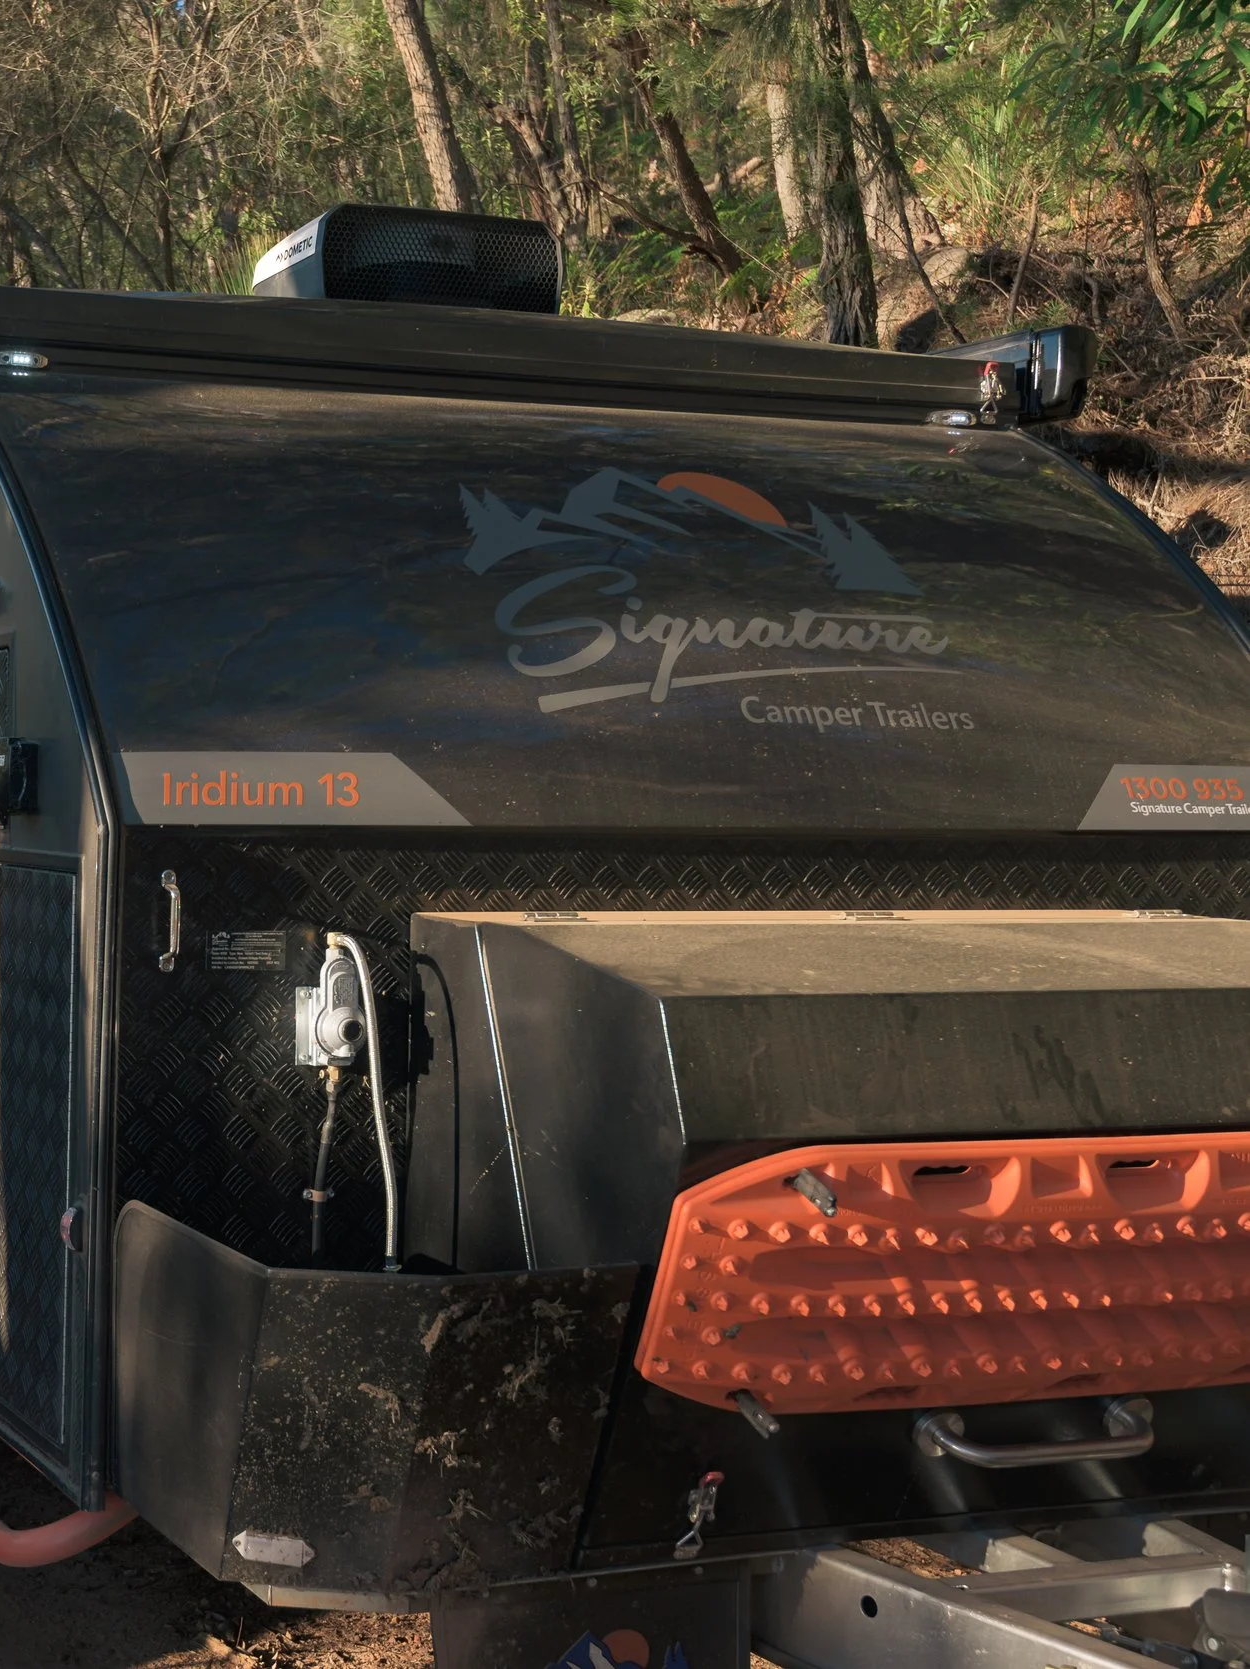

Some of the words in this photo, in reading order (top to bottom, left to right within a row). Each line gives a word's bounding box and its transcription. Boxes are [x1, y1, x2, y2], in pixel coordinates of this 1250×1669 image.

[283, 236, 313, 260] DOMETIC
[494, 565, 949, 703] Signature
[740, 695, 863, 732] Camper
[865, 700, 975, 731] Trailers
[162, 769, 304, 807] Iridium
[316, 771, 361, 807] 13
[1119, 776, 1188, 801] 1300
[1192, 778, 1245, 801] 935
[1129, 801, 1183, 817] Signature
[1183, 802, 1226, 817] Camper
